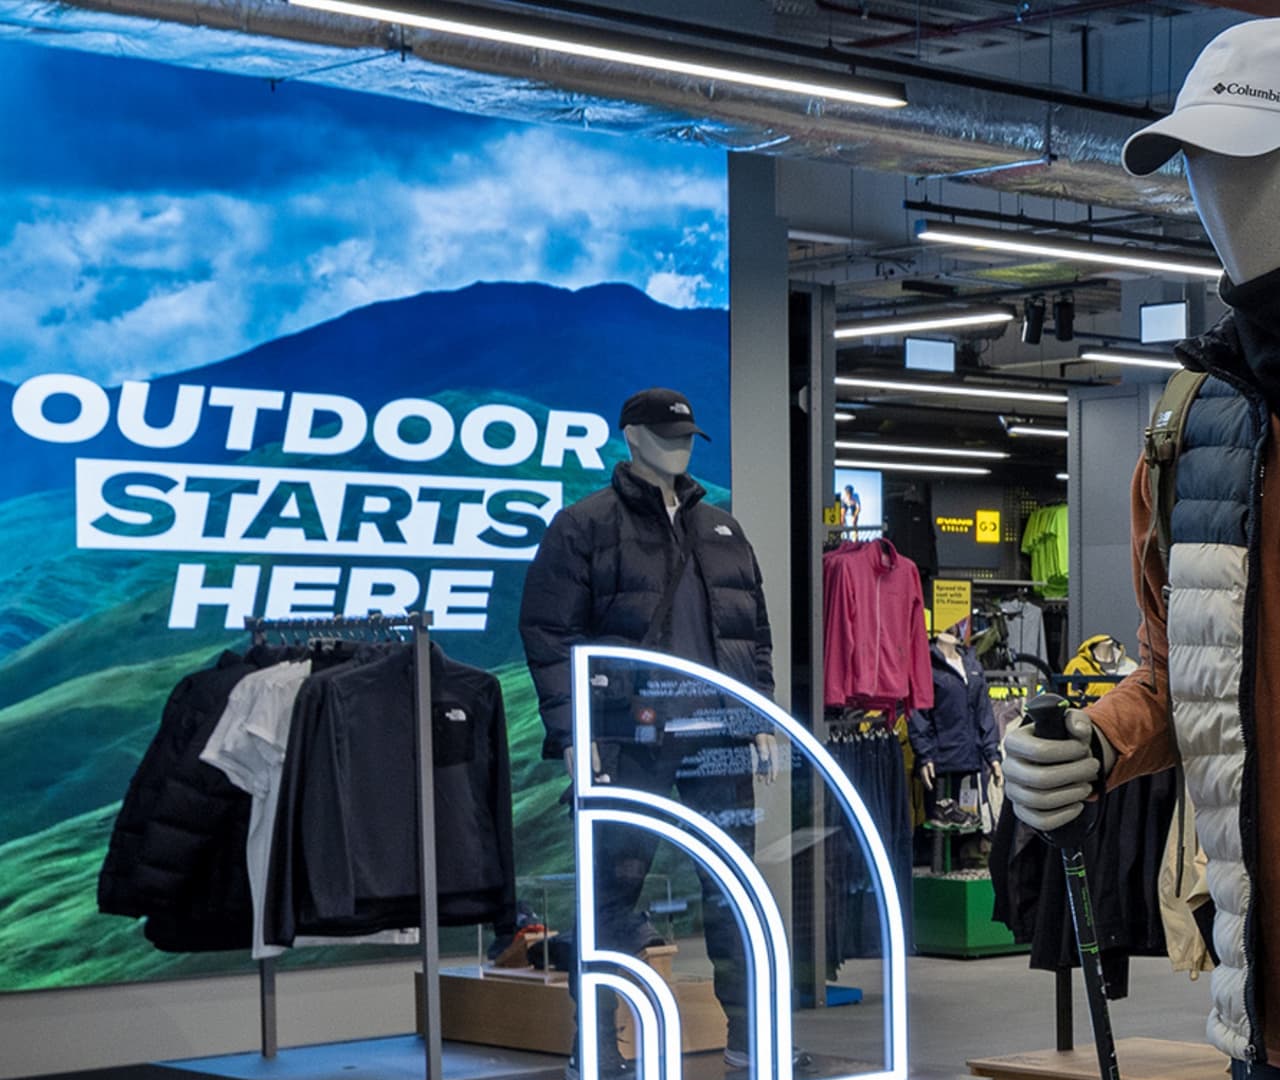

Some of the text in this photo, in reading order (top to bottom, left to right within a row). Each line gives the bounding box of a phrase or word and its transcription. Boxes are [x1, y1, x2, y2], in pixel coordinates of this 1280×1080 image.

[11, 373, 610, 469] OUTDOOR
[90, 472, 551, 549] STARTS
[167, 563, 495, 631] HERE
